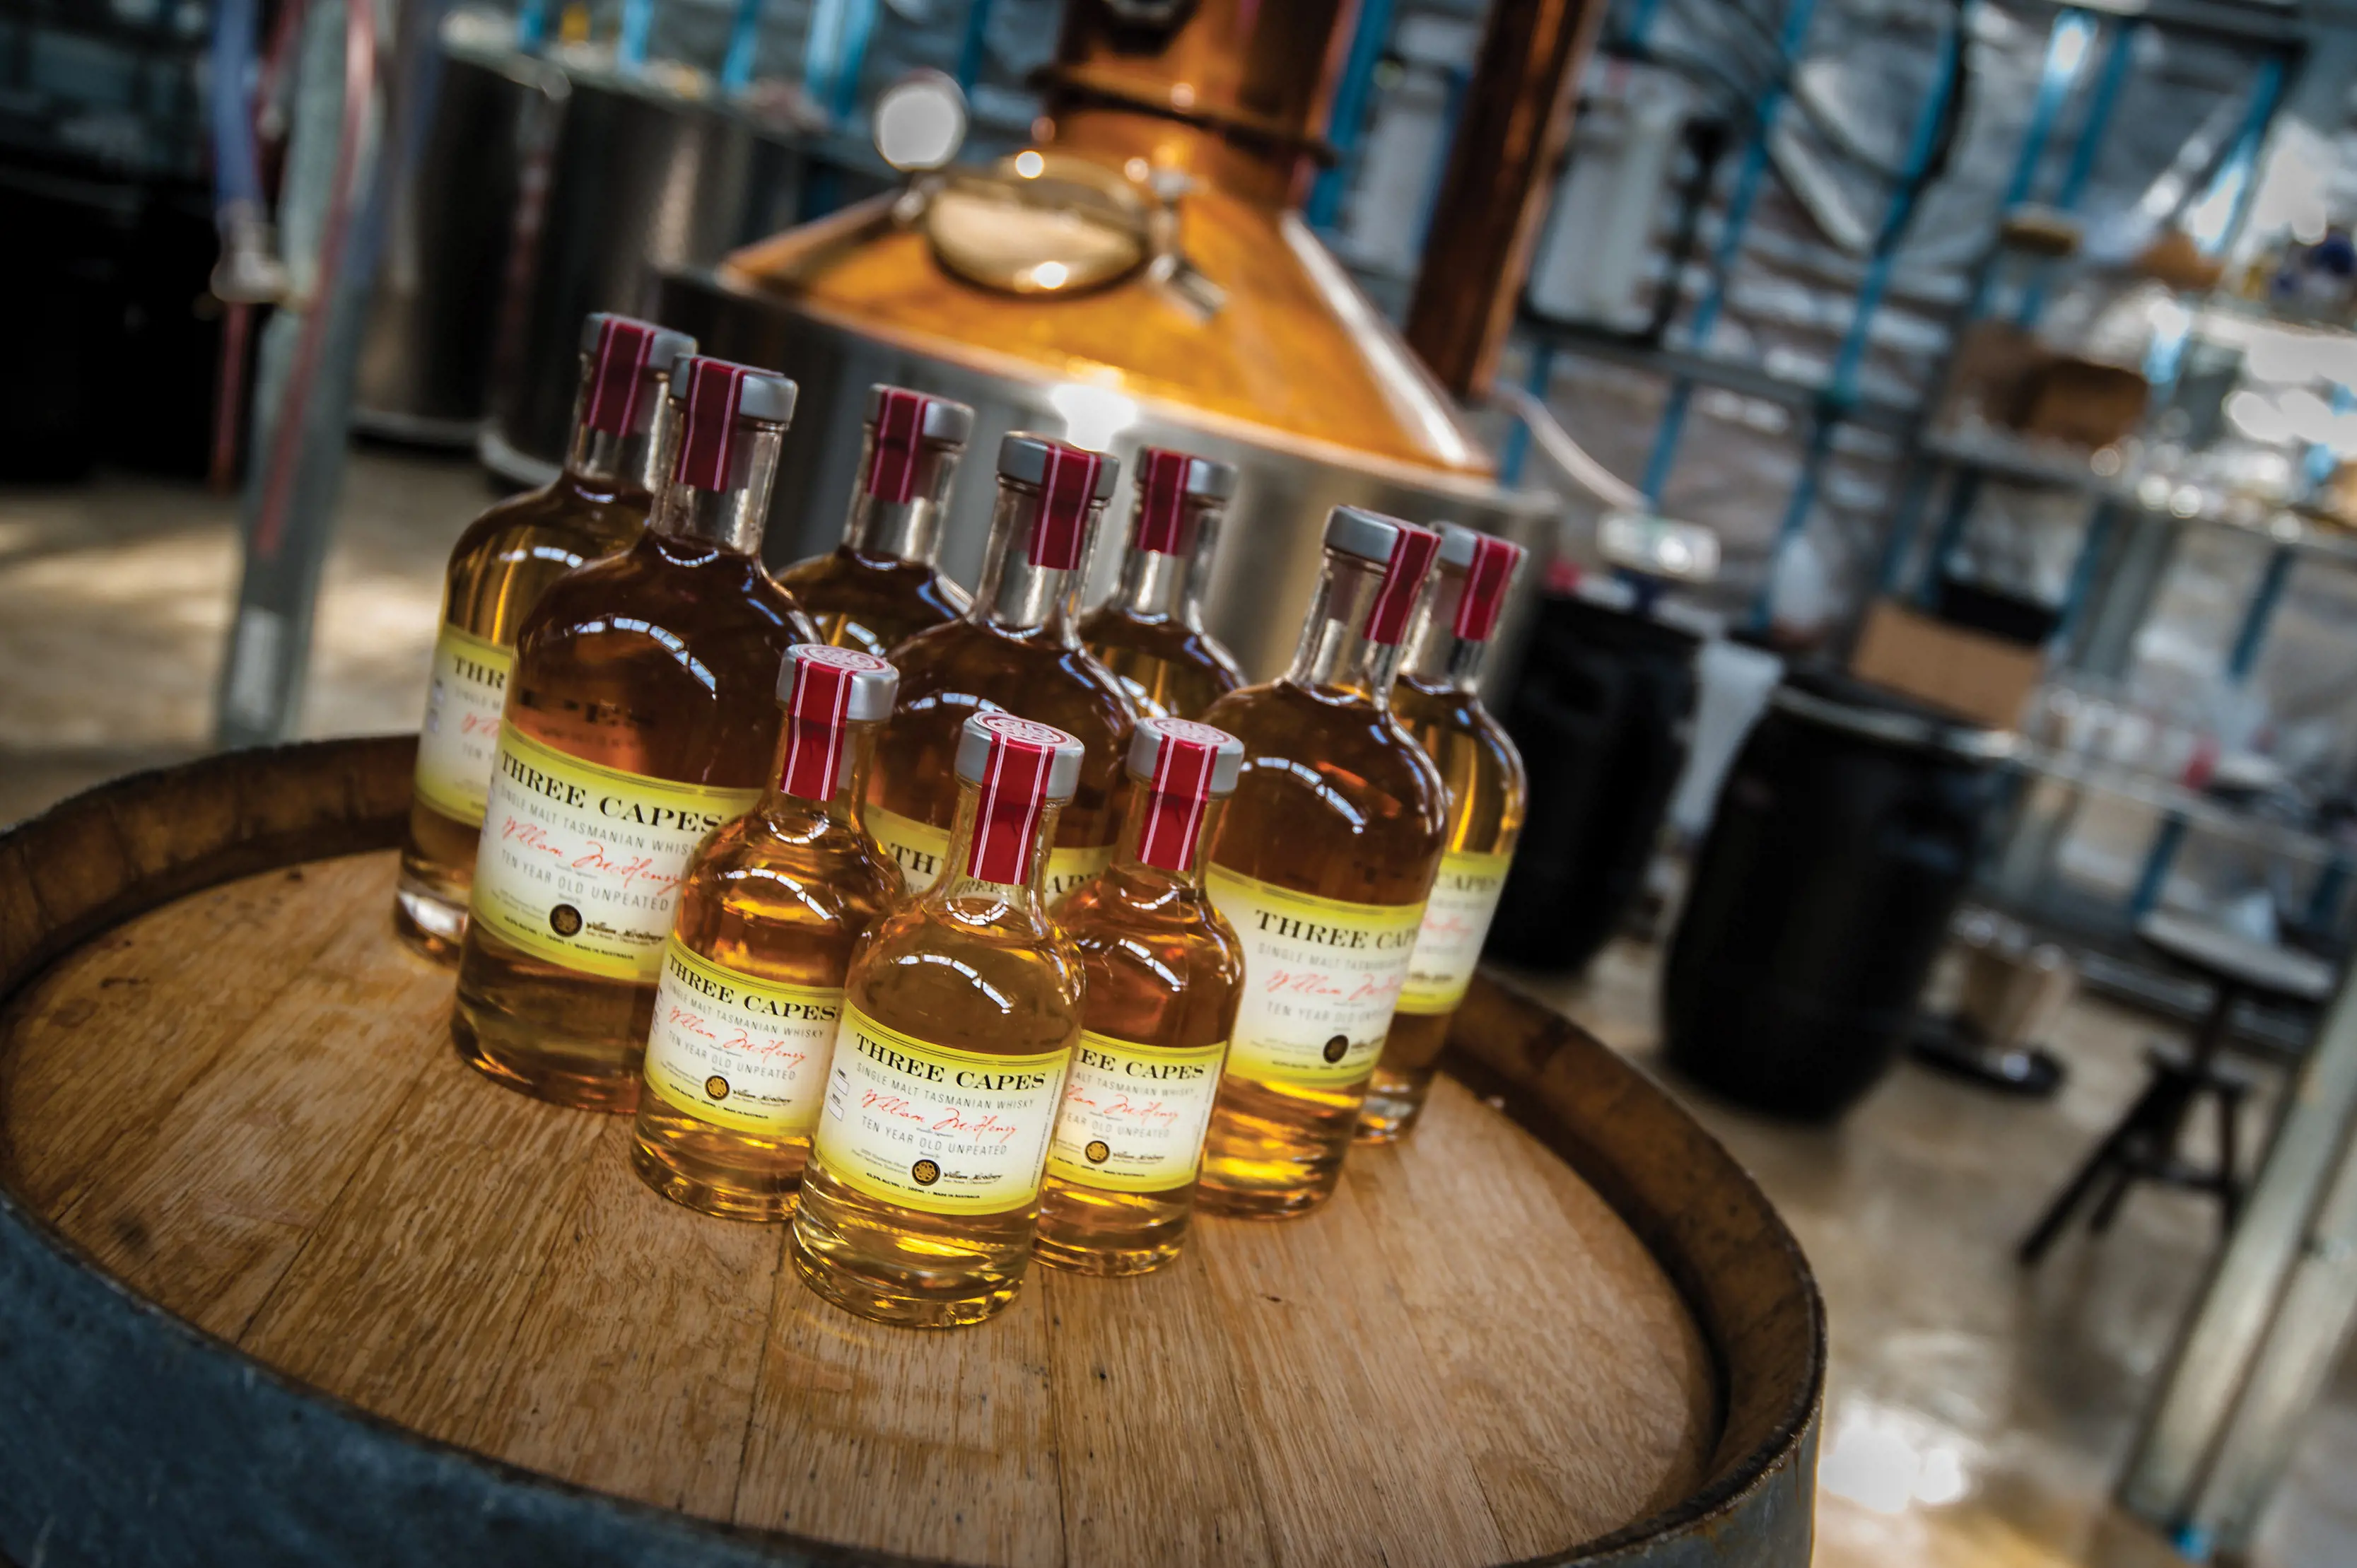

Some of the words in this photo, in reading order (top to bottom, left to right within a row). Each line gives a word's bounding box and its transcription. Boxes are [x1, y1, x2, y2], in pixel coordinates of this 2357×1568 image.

[502, 749, 586, 808] THREE
[600, 796, 722, 832] CAPES
[530, 803, 556, 824] MALT
[564, 819, 645, 848] TASMANIAN
[501, 849, 517, 869] TEN
[523, 862, 551, 884] YEAR
[558, 877, 584, 895] OLD
[592, 887, 669, 911] UNPEATED
[1255, 909, 1369, 949] THREE
[1257, 942, 1302, 963] SINGLE
[1309, 954, 1340, 969] MALT
[669, 954, 735, 1005] THREE
[744, 995, 837, 1022] CAPES
[691, 1000, 713, 1015] MALT
[716, 1010, 778, 1034] TASMANIAN
[783, 1026, 825, 1039] WHISKY
[1266, 1000, 1292, 1017] TEN
[1299, 1007, 1330, 1022] YEAR
[667, 1030, 681, 1047] TEN
[684, 1042, 707, 1060] YEAR
[711, 1055, 732, 1069] OLD
[737, 1063, 797, 1081] UNPEATED
[856, 1032, 945, 1083] THREE
[956, 1071, 1046, 1091] CAPES
[1125, 1061, 1205, 1080] CAPES
[856, 1063, 888, 1086] SINGLE
[891, 1080, 919, 1099] MALT
[924, 1089, 991, 1109] TASMANIAN
[997, 1099, 1034, 1110] WHISKY
[1097, 1077, 1158, 1096] TASMANIAN
[862, 1116, 880, 1133] TEN
[885, 1126, 913, 1144] YEAR
[920, 1137, 942, 1151] OLD
[948, 1144, 1007, 1156] UNPEATED
[1092, 1121, 1113, 1133] OLD
[1118, 1125, 1171, 1138] UNPEATED
